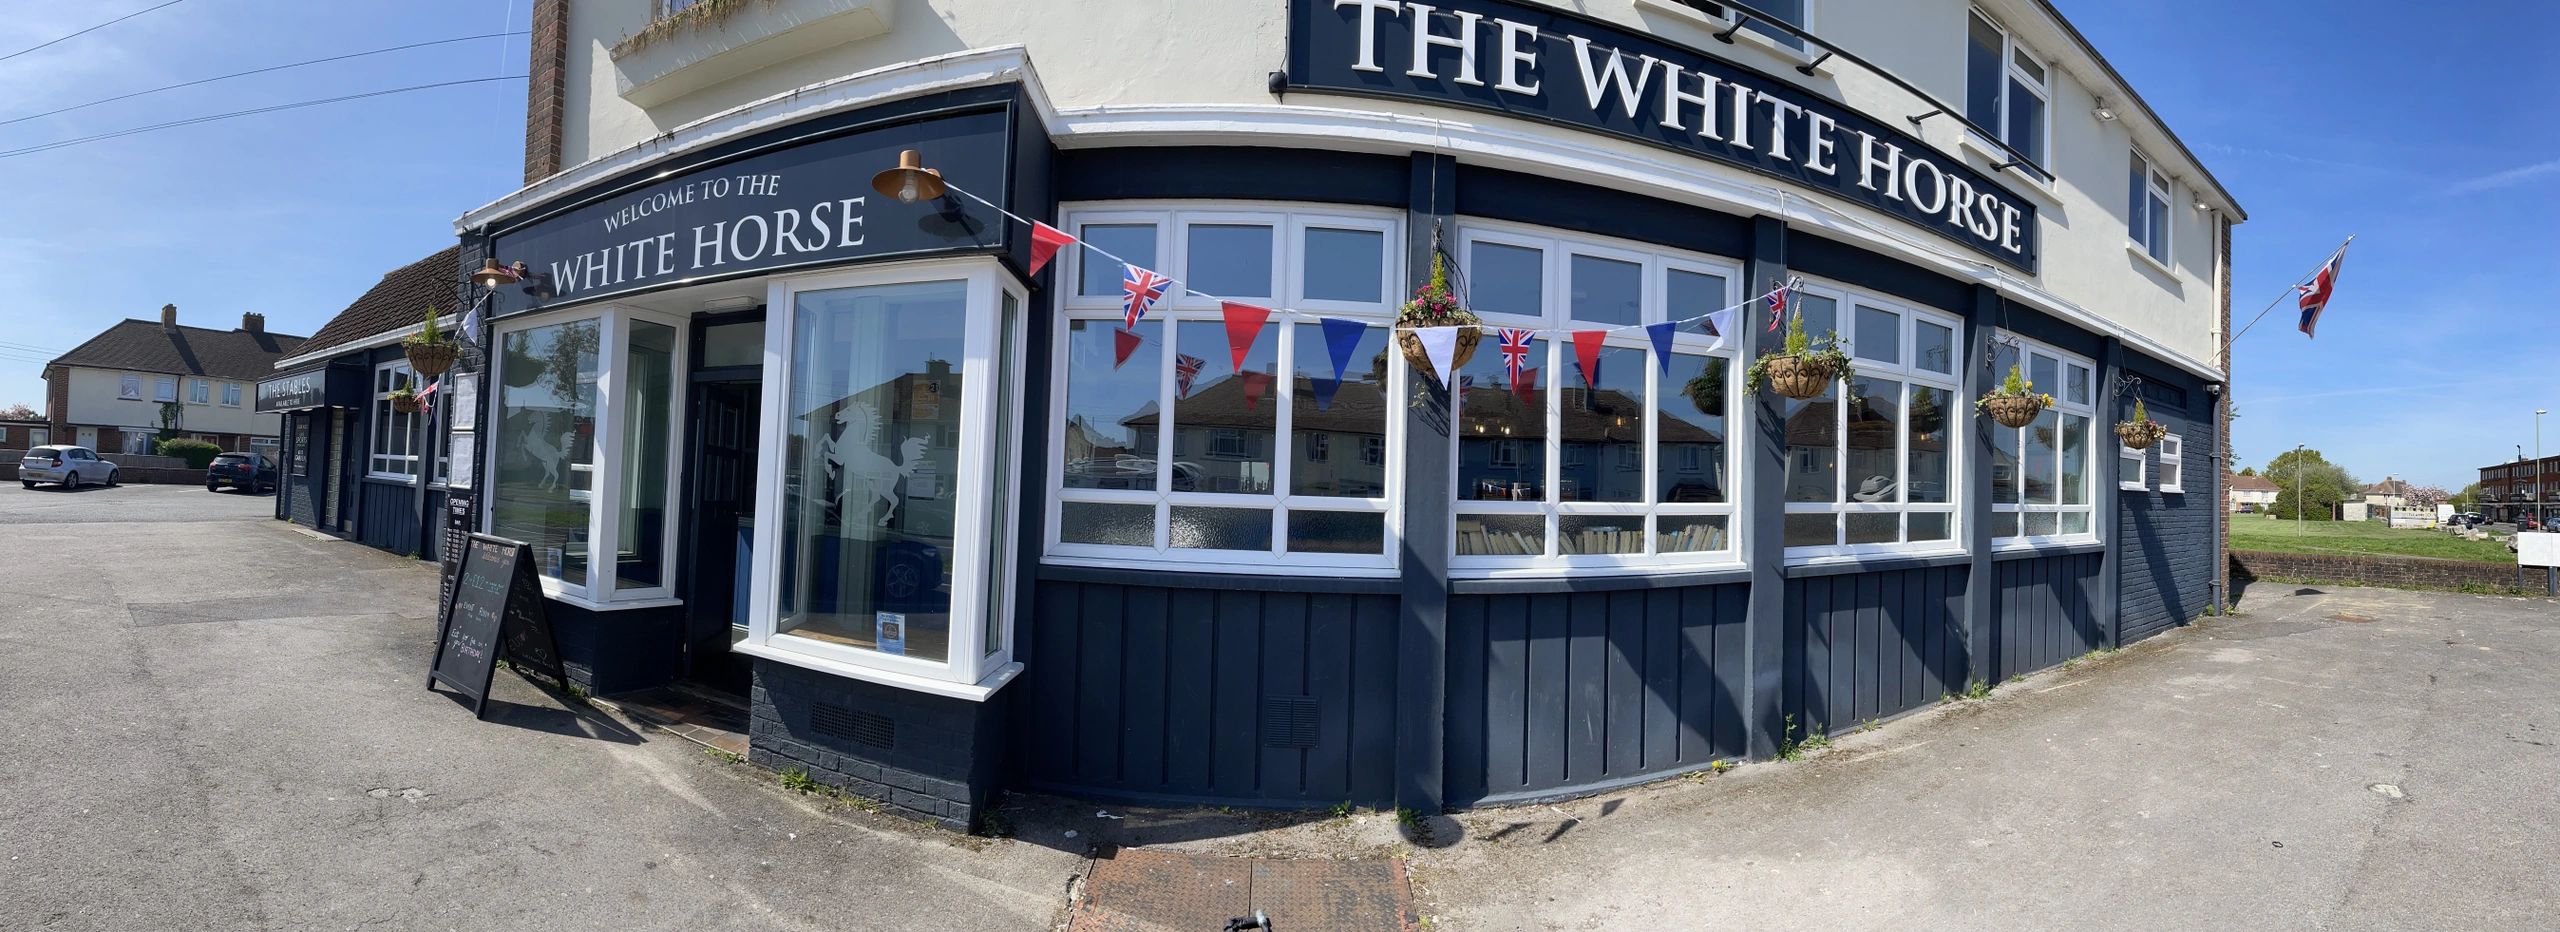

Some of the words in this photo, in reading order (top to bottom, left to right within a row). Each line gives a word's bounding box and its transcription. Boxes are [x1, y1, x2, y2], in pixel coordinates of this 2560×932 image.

[1333, 0, 1541, 97] THE
[1567, 34, 1837, 175] WHITE
[1856, 130, 2022, 255] HORSE
[604, 183, 695, 234] WELCOME
[701, 177, 730, 200] TO
[736, 174, 781, 197] THE
[551, 232, 676, 297] WHITE
[691, 196, 866, 270] HORSE
[269, 384, 280, 399] THE
[282, 377, 311, 397] STABLES
[450, 498, 469, 508] OPENING
[453, 506, 465, 515] TIMES
[471, 539, 480, 549] THE
[483, 543, 498, 553] WHITE
